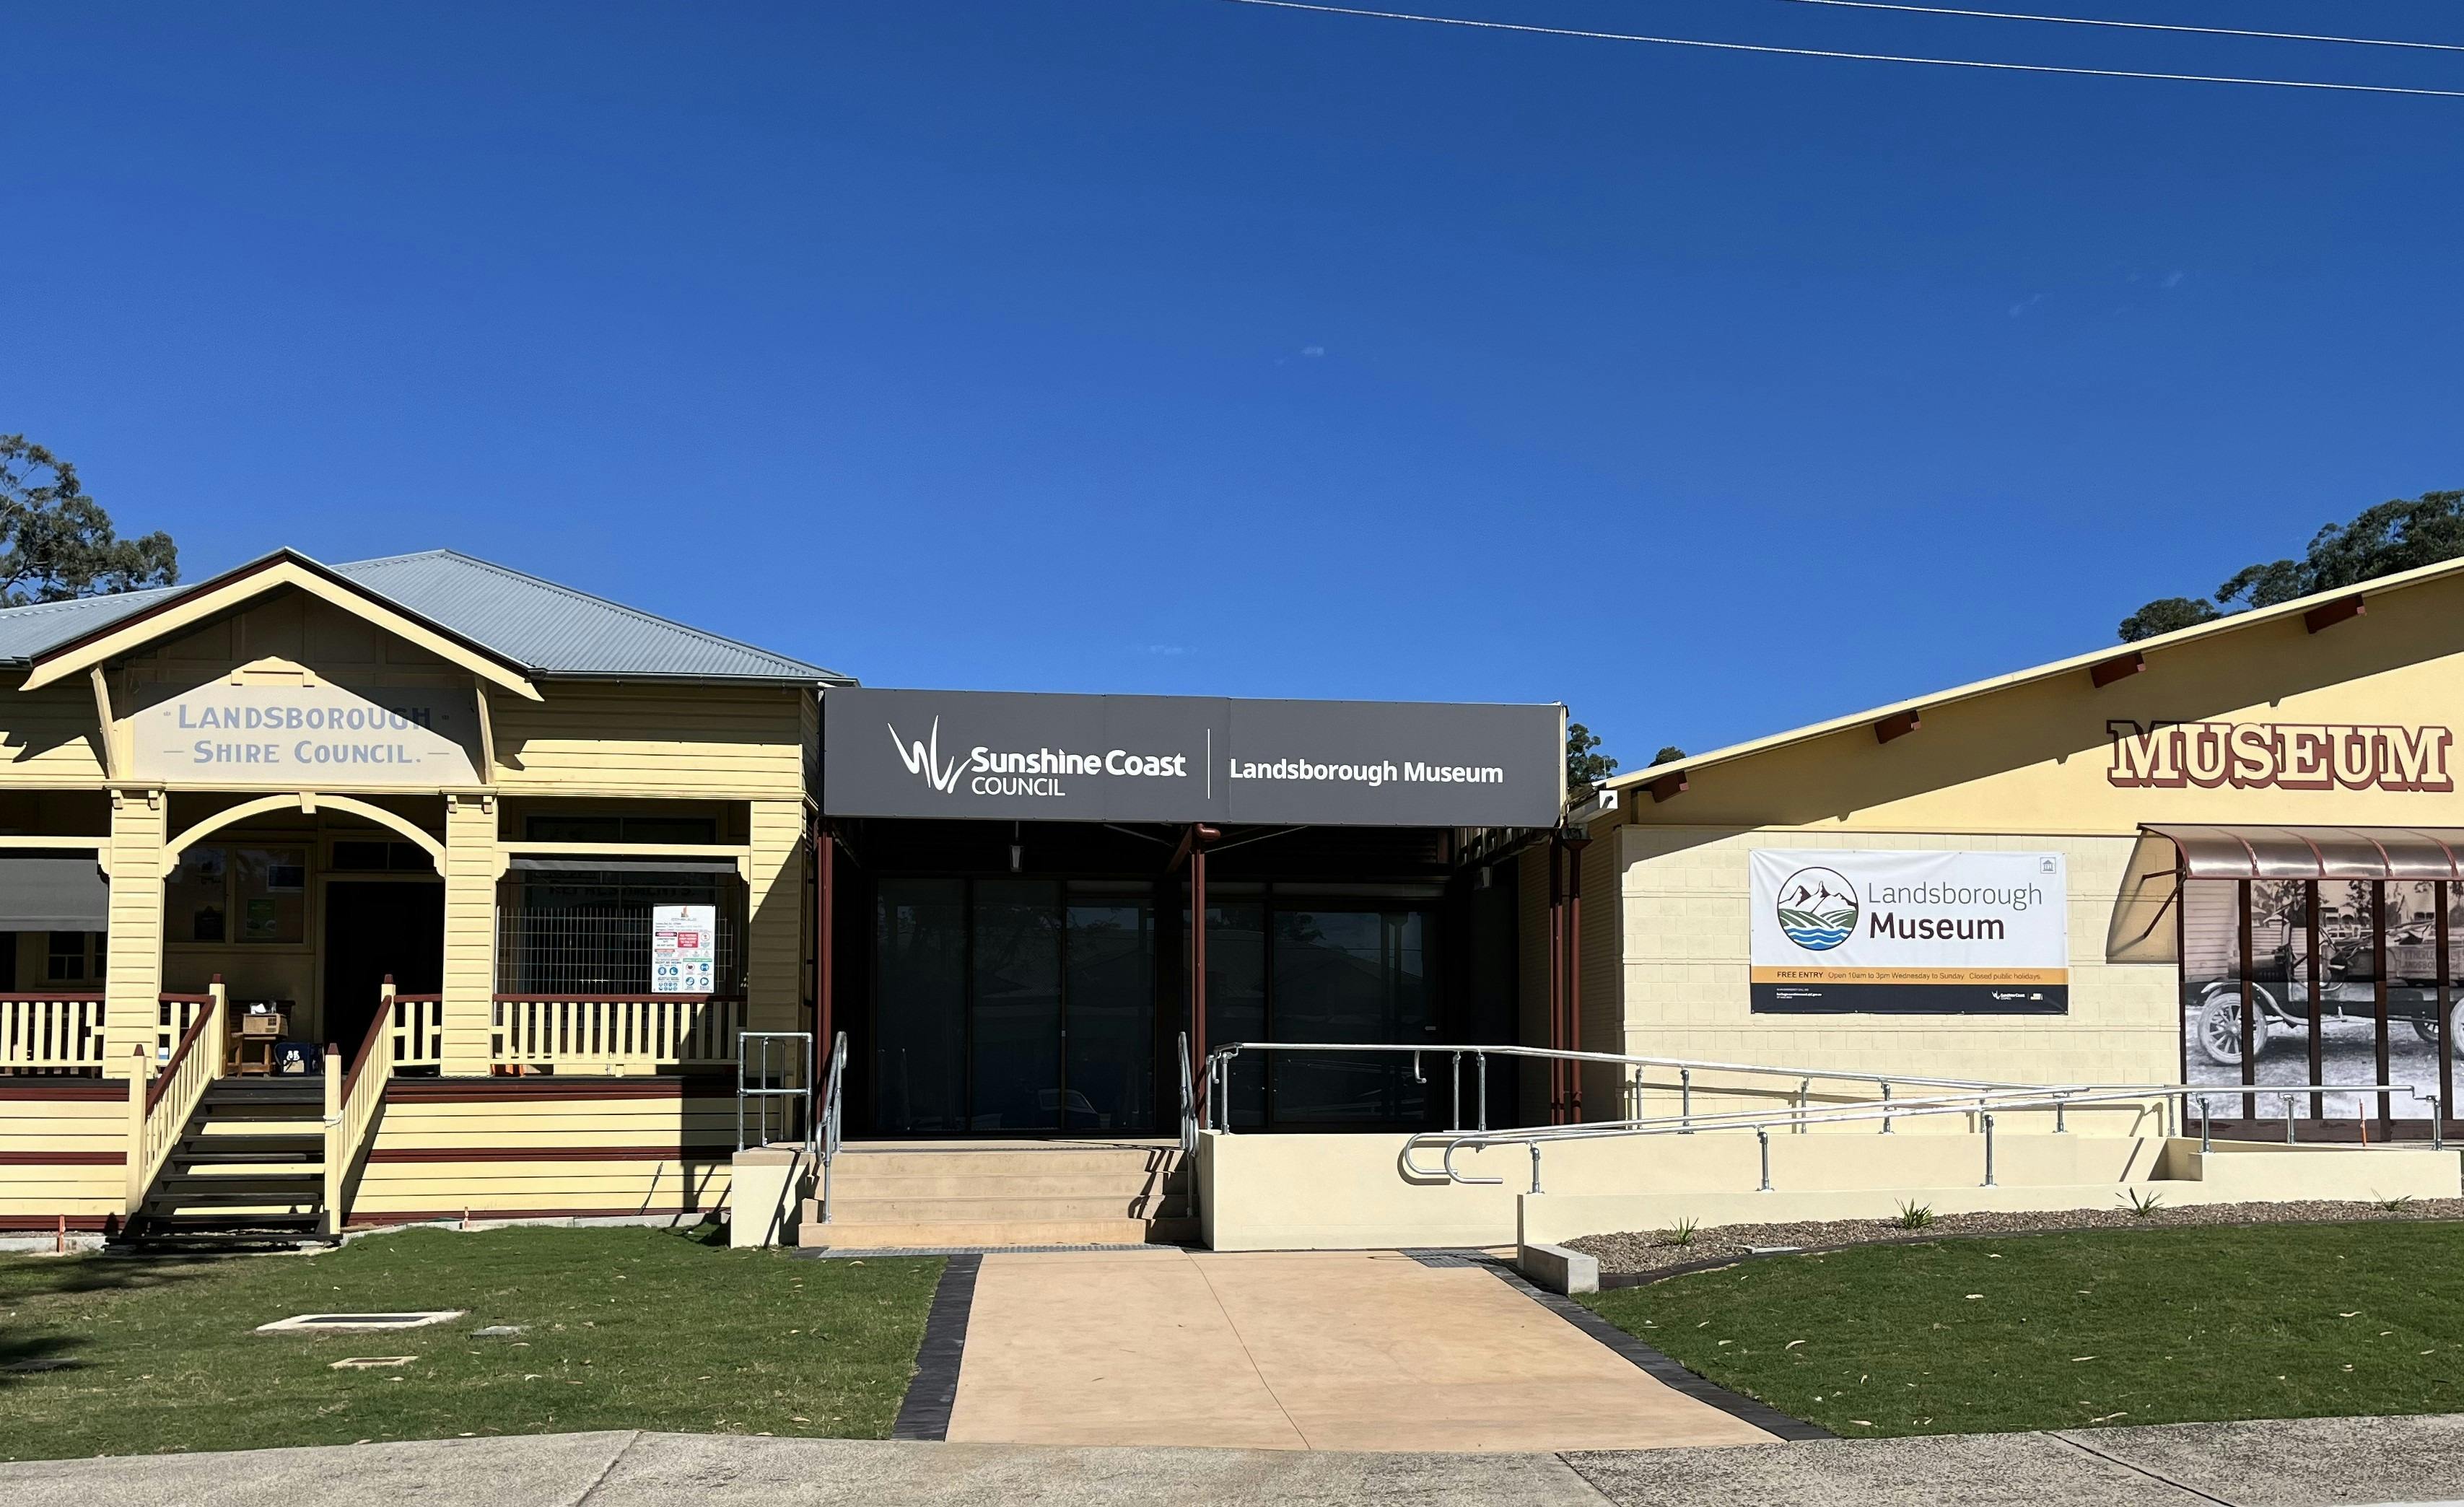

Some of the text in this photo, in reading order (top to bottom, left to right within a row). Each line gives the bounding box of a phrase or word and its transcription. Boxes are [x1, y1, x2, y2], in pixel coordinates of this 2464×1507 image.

[178, 704, 431, 730] LANDSBOROUGH
[193, 740, 421, 764] SHIRE COUNCIL.
[971, 746, 1188, 777] Sunshine Coast
[2106, 720, 2454, 792] MUSEUM
[971, 777, 1066, 796] COUNCIL
[1230, 758, 1503, 787] Landsborough Museum
[1868, 881, 2043, 911] Landsborough
[1869, 912, 2004, 940] Museum
